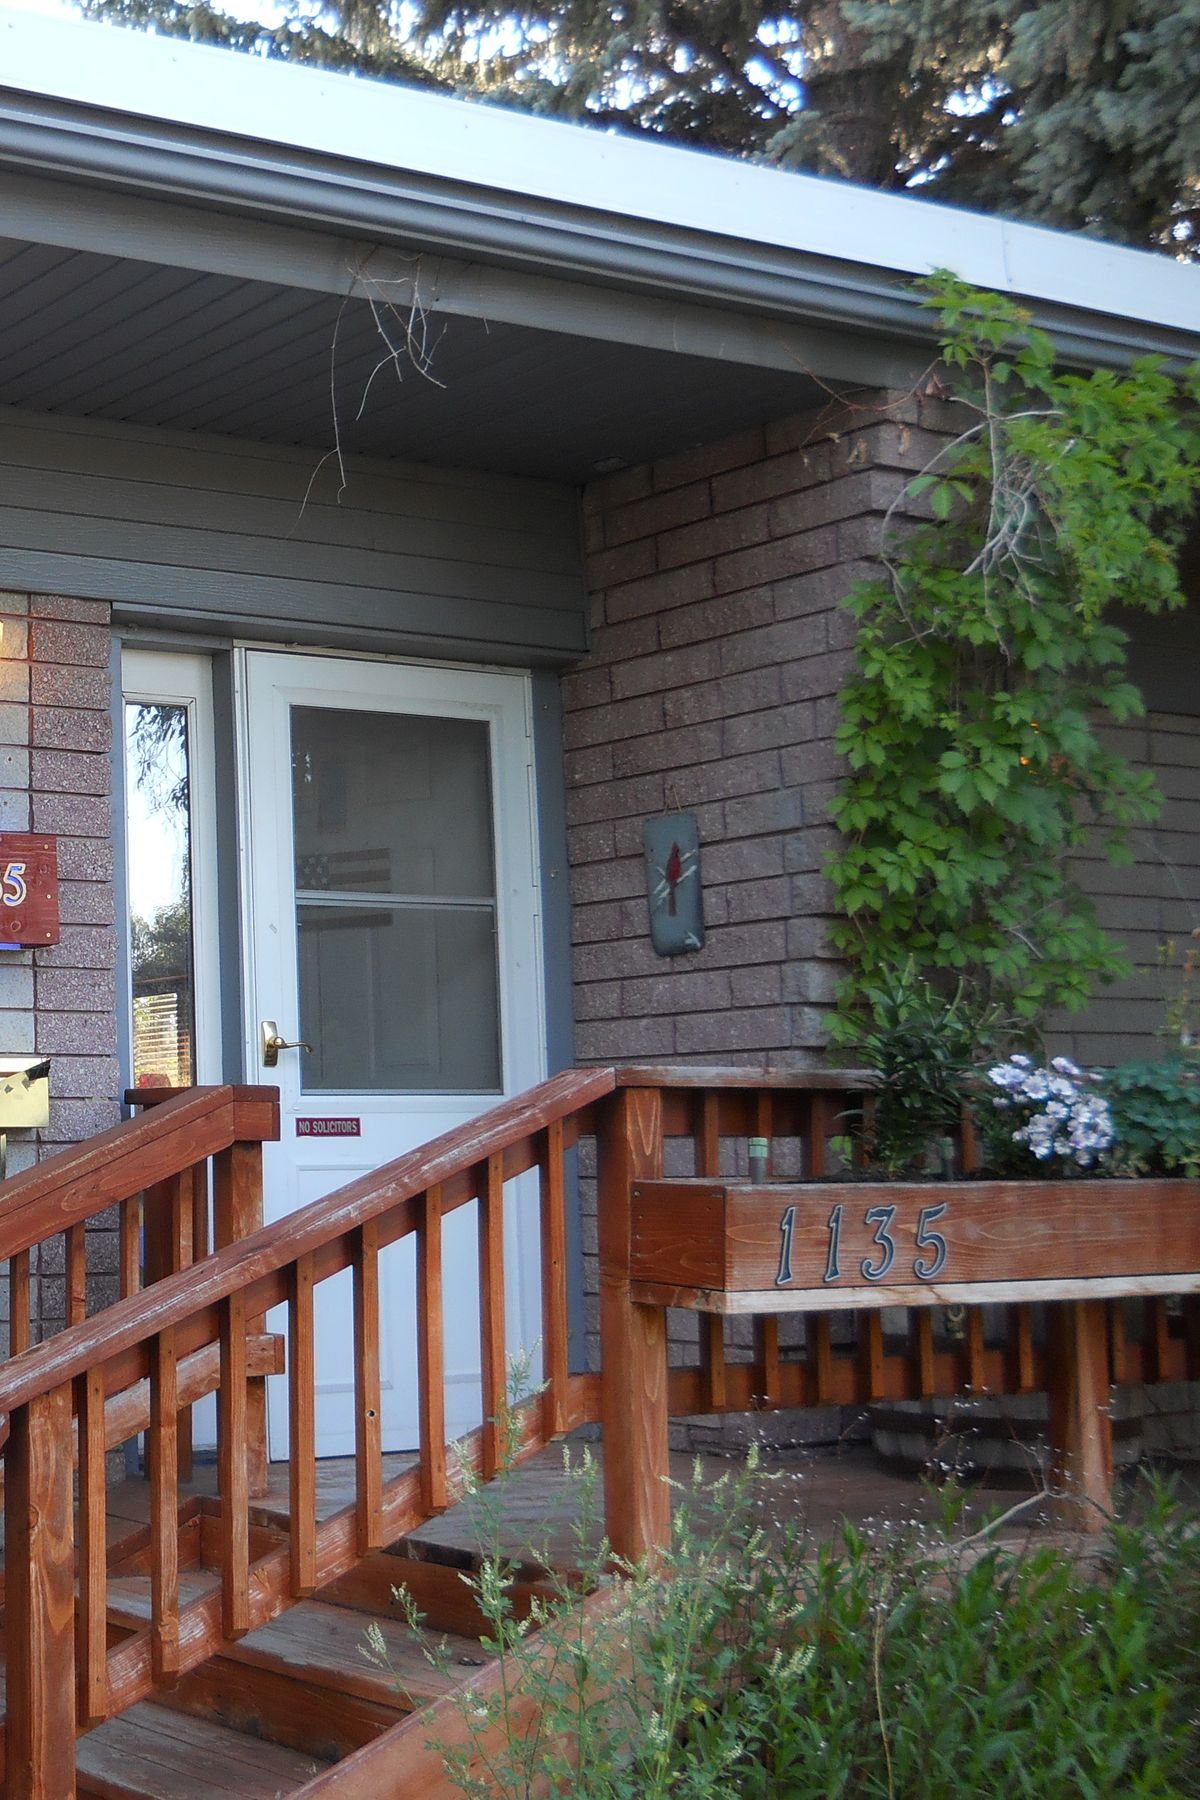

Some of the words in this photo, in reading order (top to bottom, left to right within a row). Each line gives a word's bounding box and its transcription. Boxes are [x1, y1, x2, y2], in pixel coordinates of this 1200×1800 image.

[299, 1121, 310, 1133] NO
[312, 1121, 357, 1133] SOLICITORS
[776, 1203, 947, 1285] 1135
